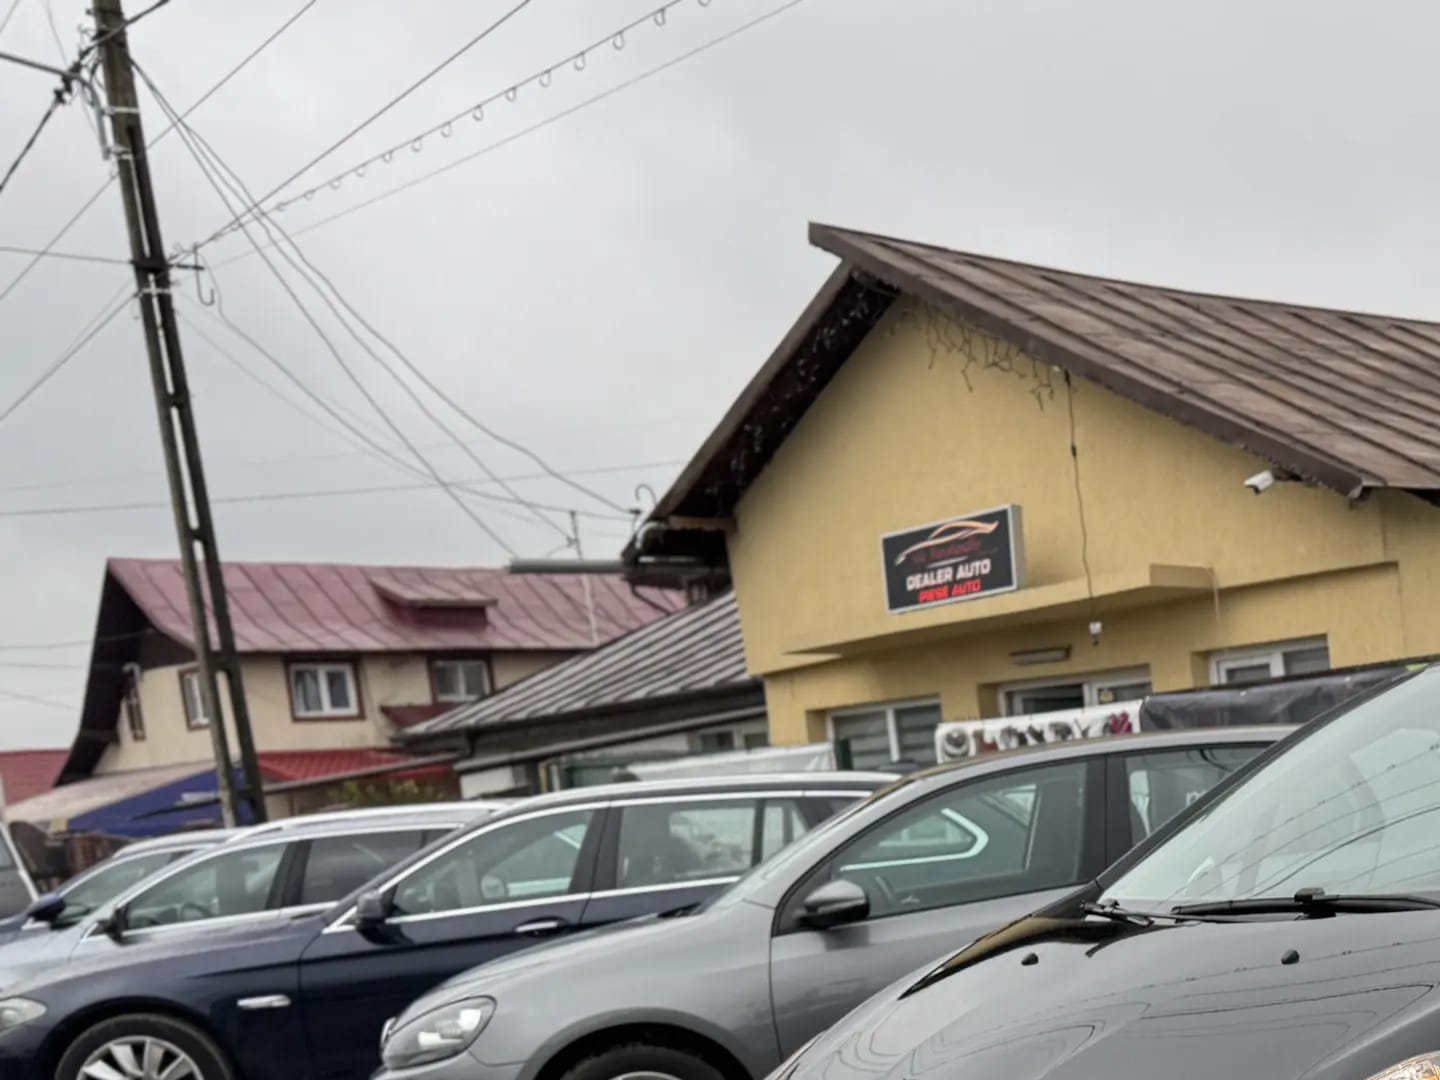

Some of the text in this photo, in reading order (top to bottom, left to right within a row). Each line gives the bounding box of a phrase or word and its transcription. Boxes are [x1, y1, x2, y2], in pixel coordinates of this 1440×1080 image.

[906, 558, 991, 591] DEALER AUTO
[952, 579, 982, 597] AUTO
